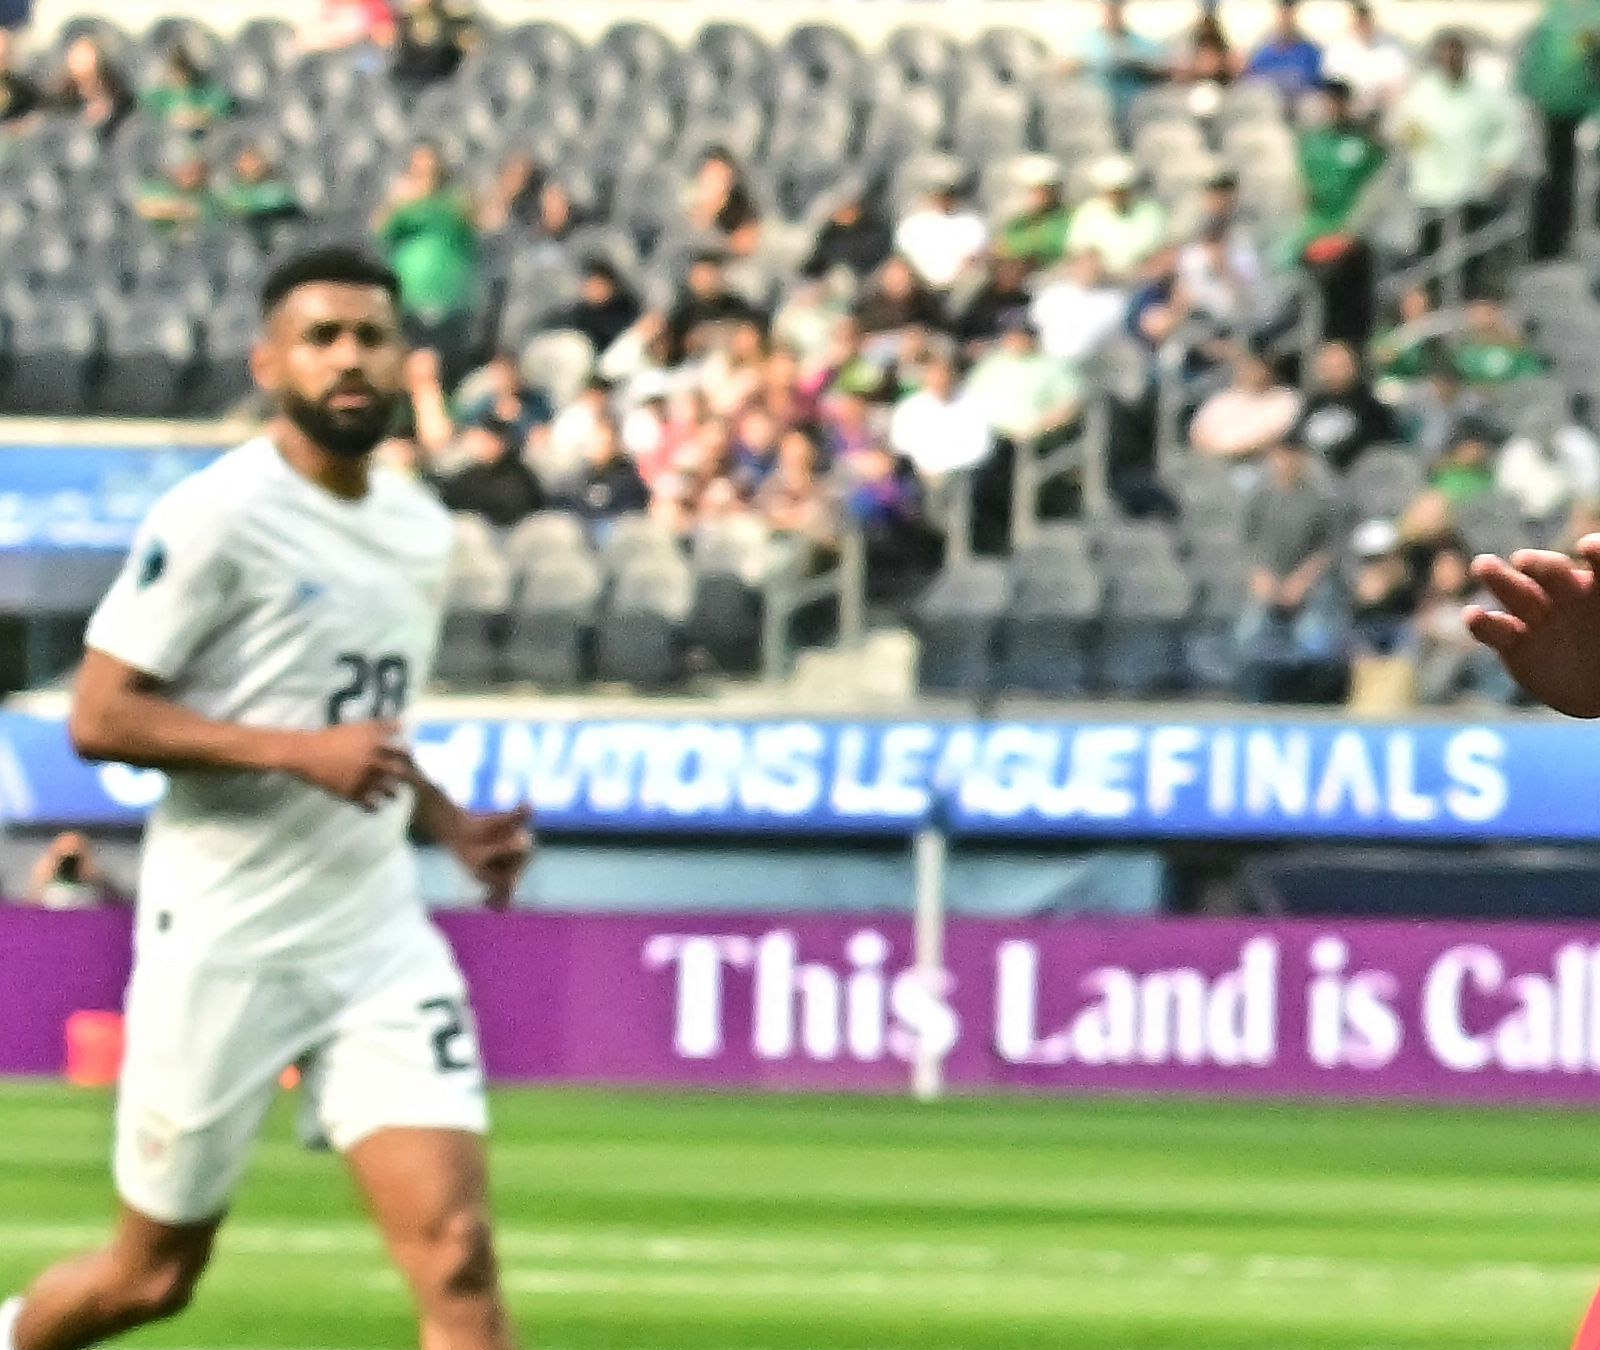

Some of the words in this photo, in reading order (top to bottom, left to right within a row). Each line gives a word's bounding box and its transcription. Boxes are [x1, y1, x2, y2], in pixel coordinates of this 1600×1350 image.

[828, 722, 1141, 818] LEAGUE
[1145, 726, 1508, 822] FINALS
[642, 928, 961, 1062] This
[993, 935, 1281, 1067] Land
[1307, 935, 1402, 1070] is
